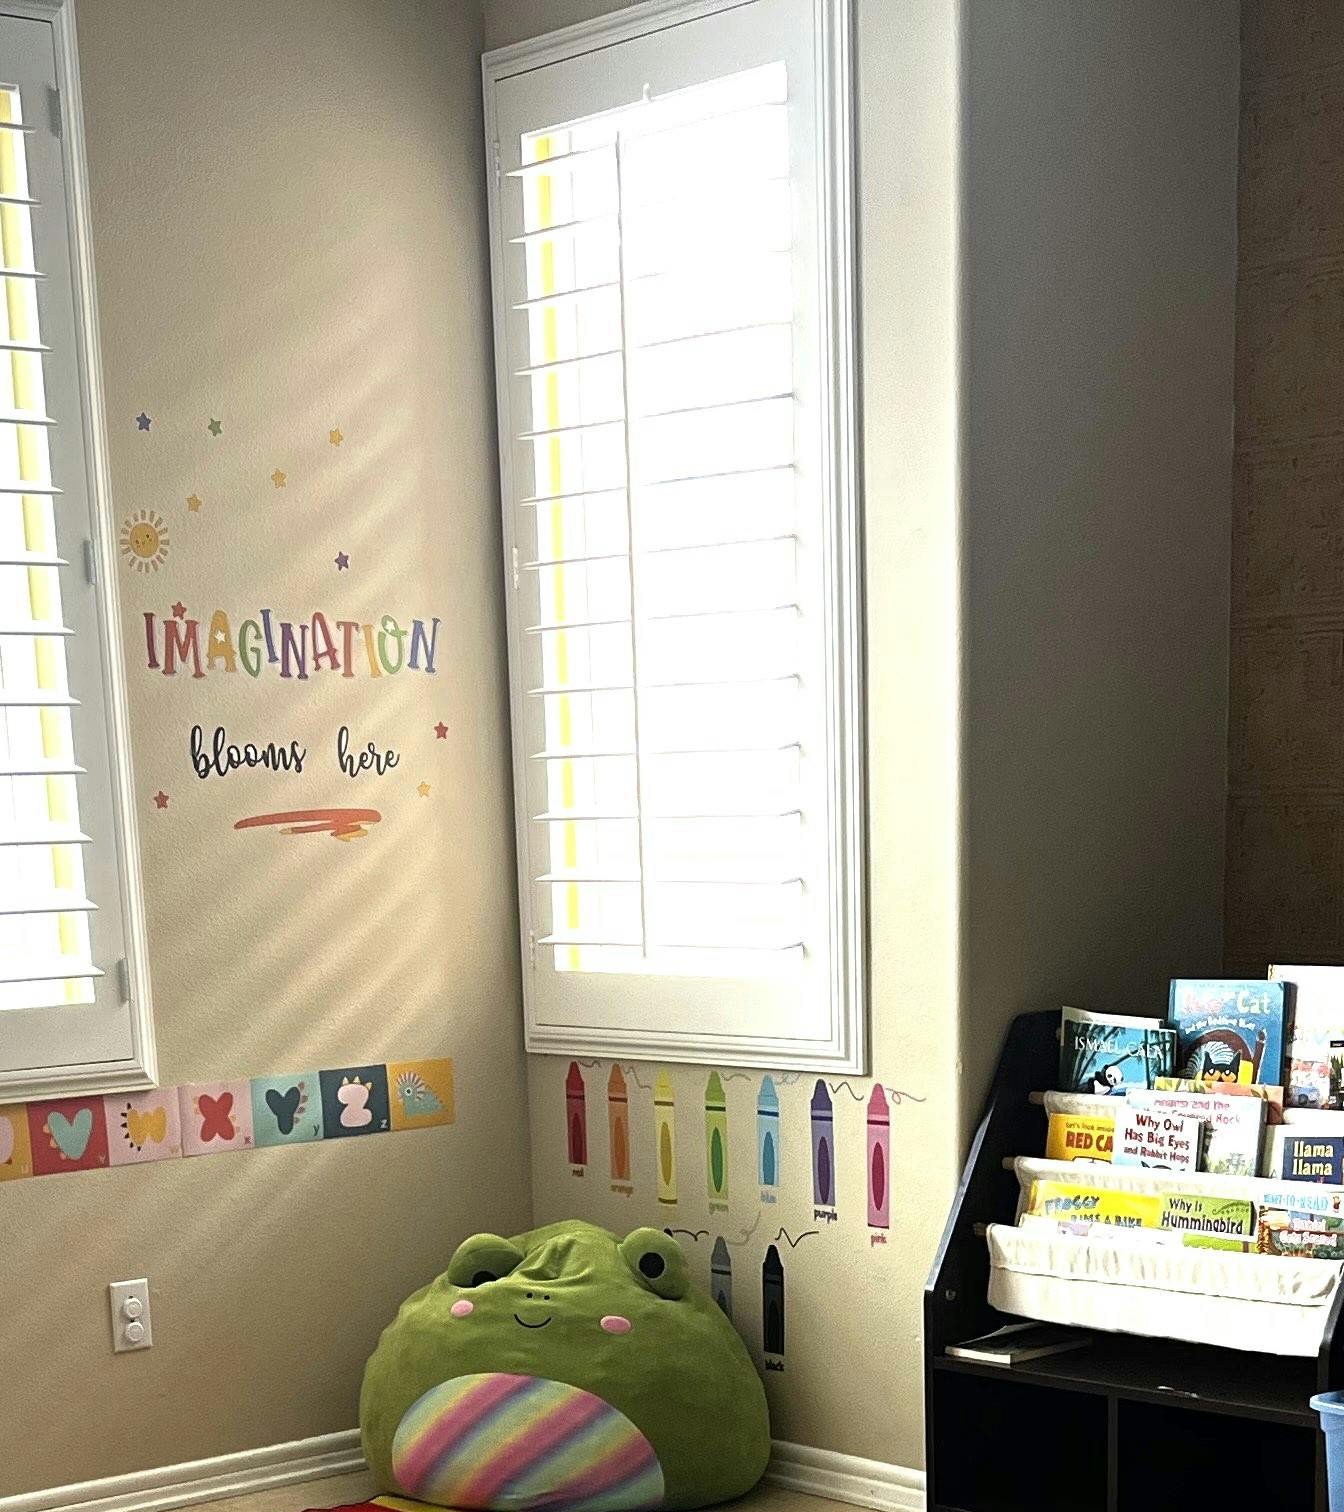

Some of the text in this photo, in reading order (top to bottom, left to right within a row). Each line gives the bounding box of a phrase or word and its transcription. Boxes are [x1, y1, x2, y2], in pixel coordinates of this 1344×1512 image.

[143, 608, 442, 679] IMAGINATION
[190, 725, 401, 779] blooms here
[1236, 990, 1271, 1014] Cat
[1075, 1036, 1121, 1054] ISMAEL
[48, 1108, 93, 1160] V
[127, 1106, 167, 1146] W
[198, 1092, 236, 1142] X
[265, 1086, 301, 1135] Y
[1136, 1114, 1160, 1132] Why
[1164, 1119, 1184, 1133] Owl
[1066, 1131, 1093, 1149] RED
[1125, 1128, 1189, 1151] Has Big Eyes
[1124, 1146, 1189, 1164] and Rabbit Hops
[1294, 1141, 1334, 1158] llama
[1292, 1158, 1333, 1175] llama
[1170, 1198, 1193, 1212] Why
[814, 1209, 837, 1224] purple
[1162, 1211, 1243, 1234] Hummingbird
[871, 1234, 887, 1247] pink
